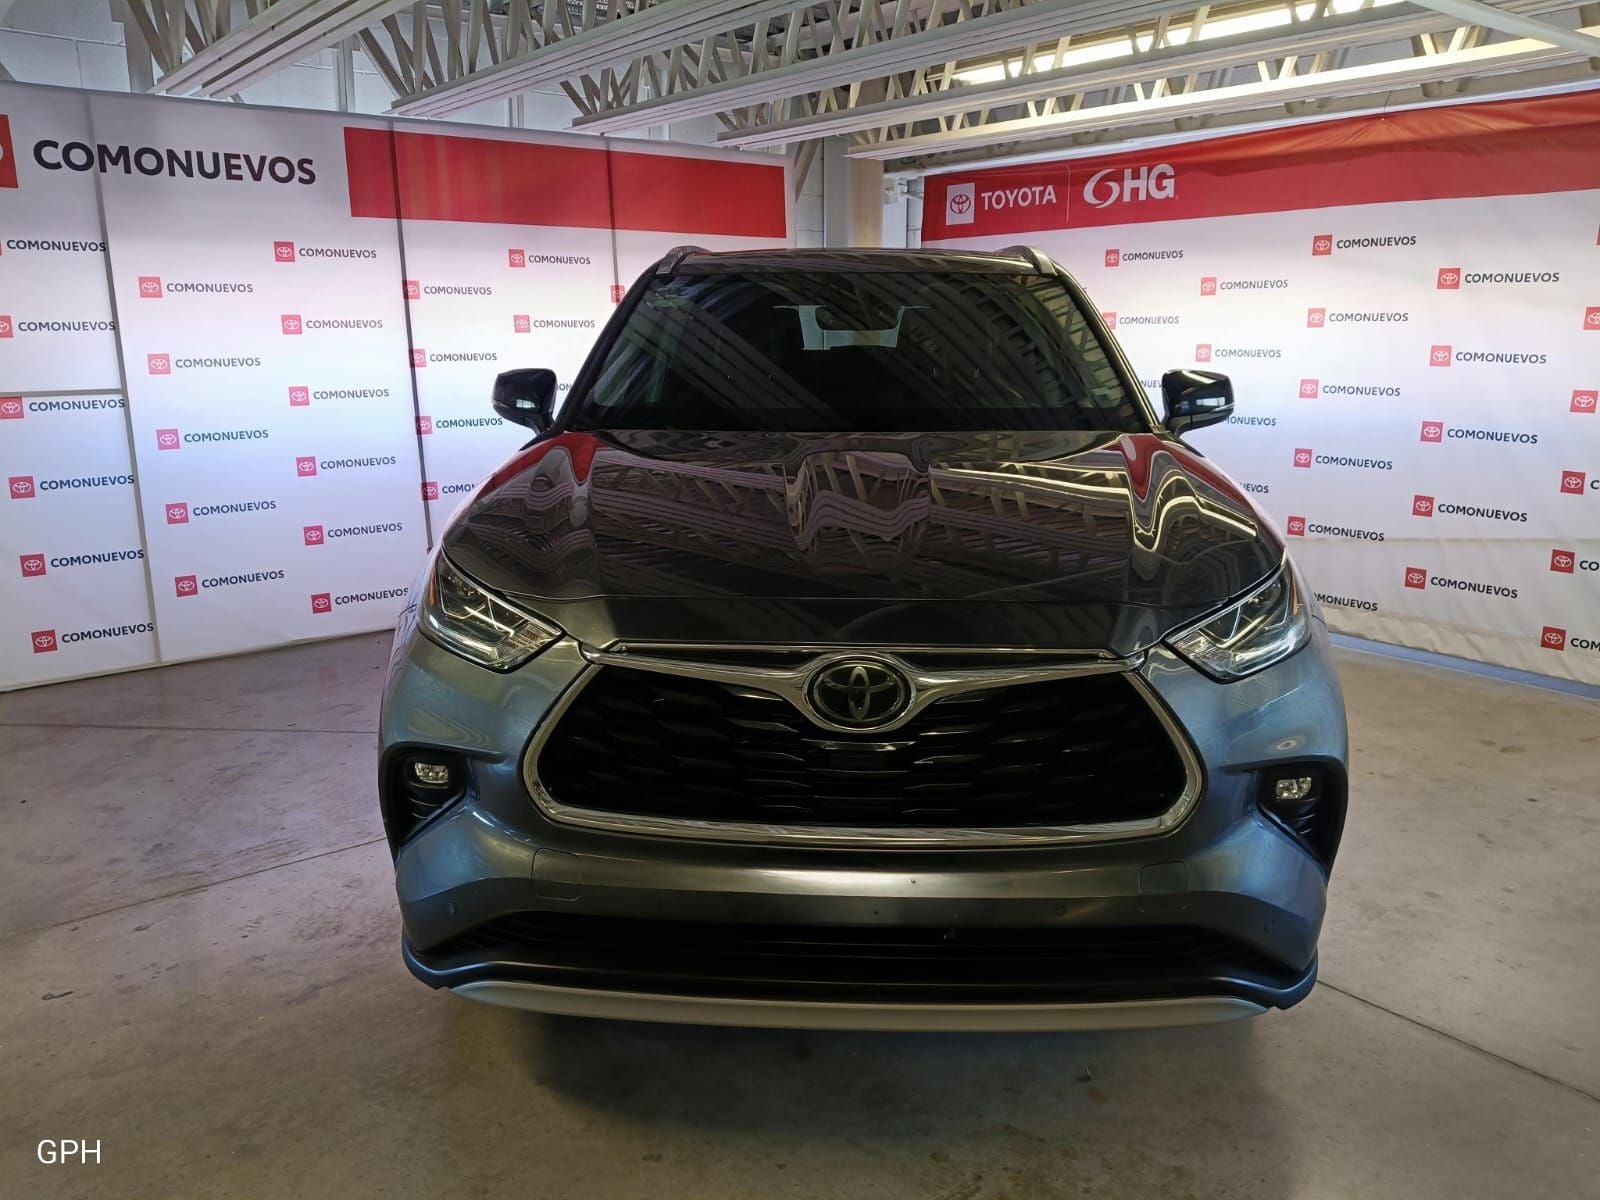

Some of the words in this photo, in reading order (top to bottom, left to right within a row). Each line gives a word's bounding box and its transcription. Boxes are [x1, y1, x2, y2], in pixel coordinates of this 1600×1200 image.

[32, 139, 316, 186] COMONUEVOS
[981, 185, 1057, 210] TOYOTA
[7, 239, 106, 253] COMONUEVOS
[1336, 235, 1417, 249] COMONUEVOS
[298, 247, 377, 259] COMONUEVOS
[528, 254, 591, 265] COMONUEVOS
[1122, 249, 1184, 262] COMONUEVOS
[1464, 272, 1560, 284] COMONUEVOS
[166, 282, 254, 293] COMONUEVOS
[423, 285, 492, 296] COMONUEVOS
[1219, 279, 1289, 291] COMONUEVOS
[1118, 315, 1180, 325] COMONUEVOS
[1328, 312, 1409, 322] COMONUEVOS
[18, 321, 116, 333] COMONUEVOS
[305, 319, 384, 329] COMONUEVOS
[532, 319, 596, 329] COMONUEVOS
[429, 352, 498, 363] COMONUEVOS
[1214, 348, 1282, 359] COMONUEVOS
[1455, 351, 1547, 364] COMONUEVOS
[175, 357, 261, 369] COMONUEVOS
[313, 388, 390, 400] COMONUEVOS
[1322, 384, 1401, 397] COMONUEVOS
[29, 398, 126, 412] COMONUEVOS
[435, 417, 504, 429] COMONUEVOS
[183, 429, 269, 443] COMONUEVOS
[1447, 428, 1538, 445] COMONUEVOS
[320, 455, 397, 470] COMONUEVOS
[1315, 455, 1393, 471] COMONUEVOS
[40, 474, 135, 491] COMONUEVOS
[192, 500, 277, 517] COMONUEVOS
[1437, 503, 1528, 523] COMONUEVOS
[327, 522, 403, 538] COMONUEVOS
[1307, 523, 1385, 542] COMONUEVOS
[50, 549, 144, 568] COMONUEVOS
[201, 569, 285, 589] COMONUEVOS
[1430, 576, 1518, 599] COMONUEVOS
[1313, 592, 1379, 612] MONUEVOS
[61, 622, 154, 644] COMONUEVOS
